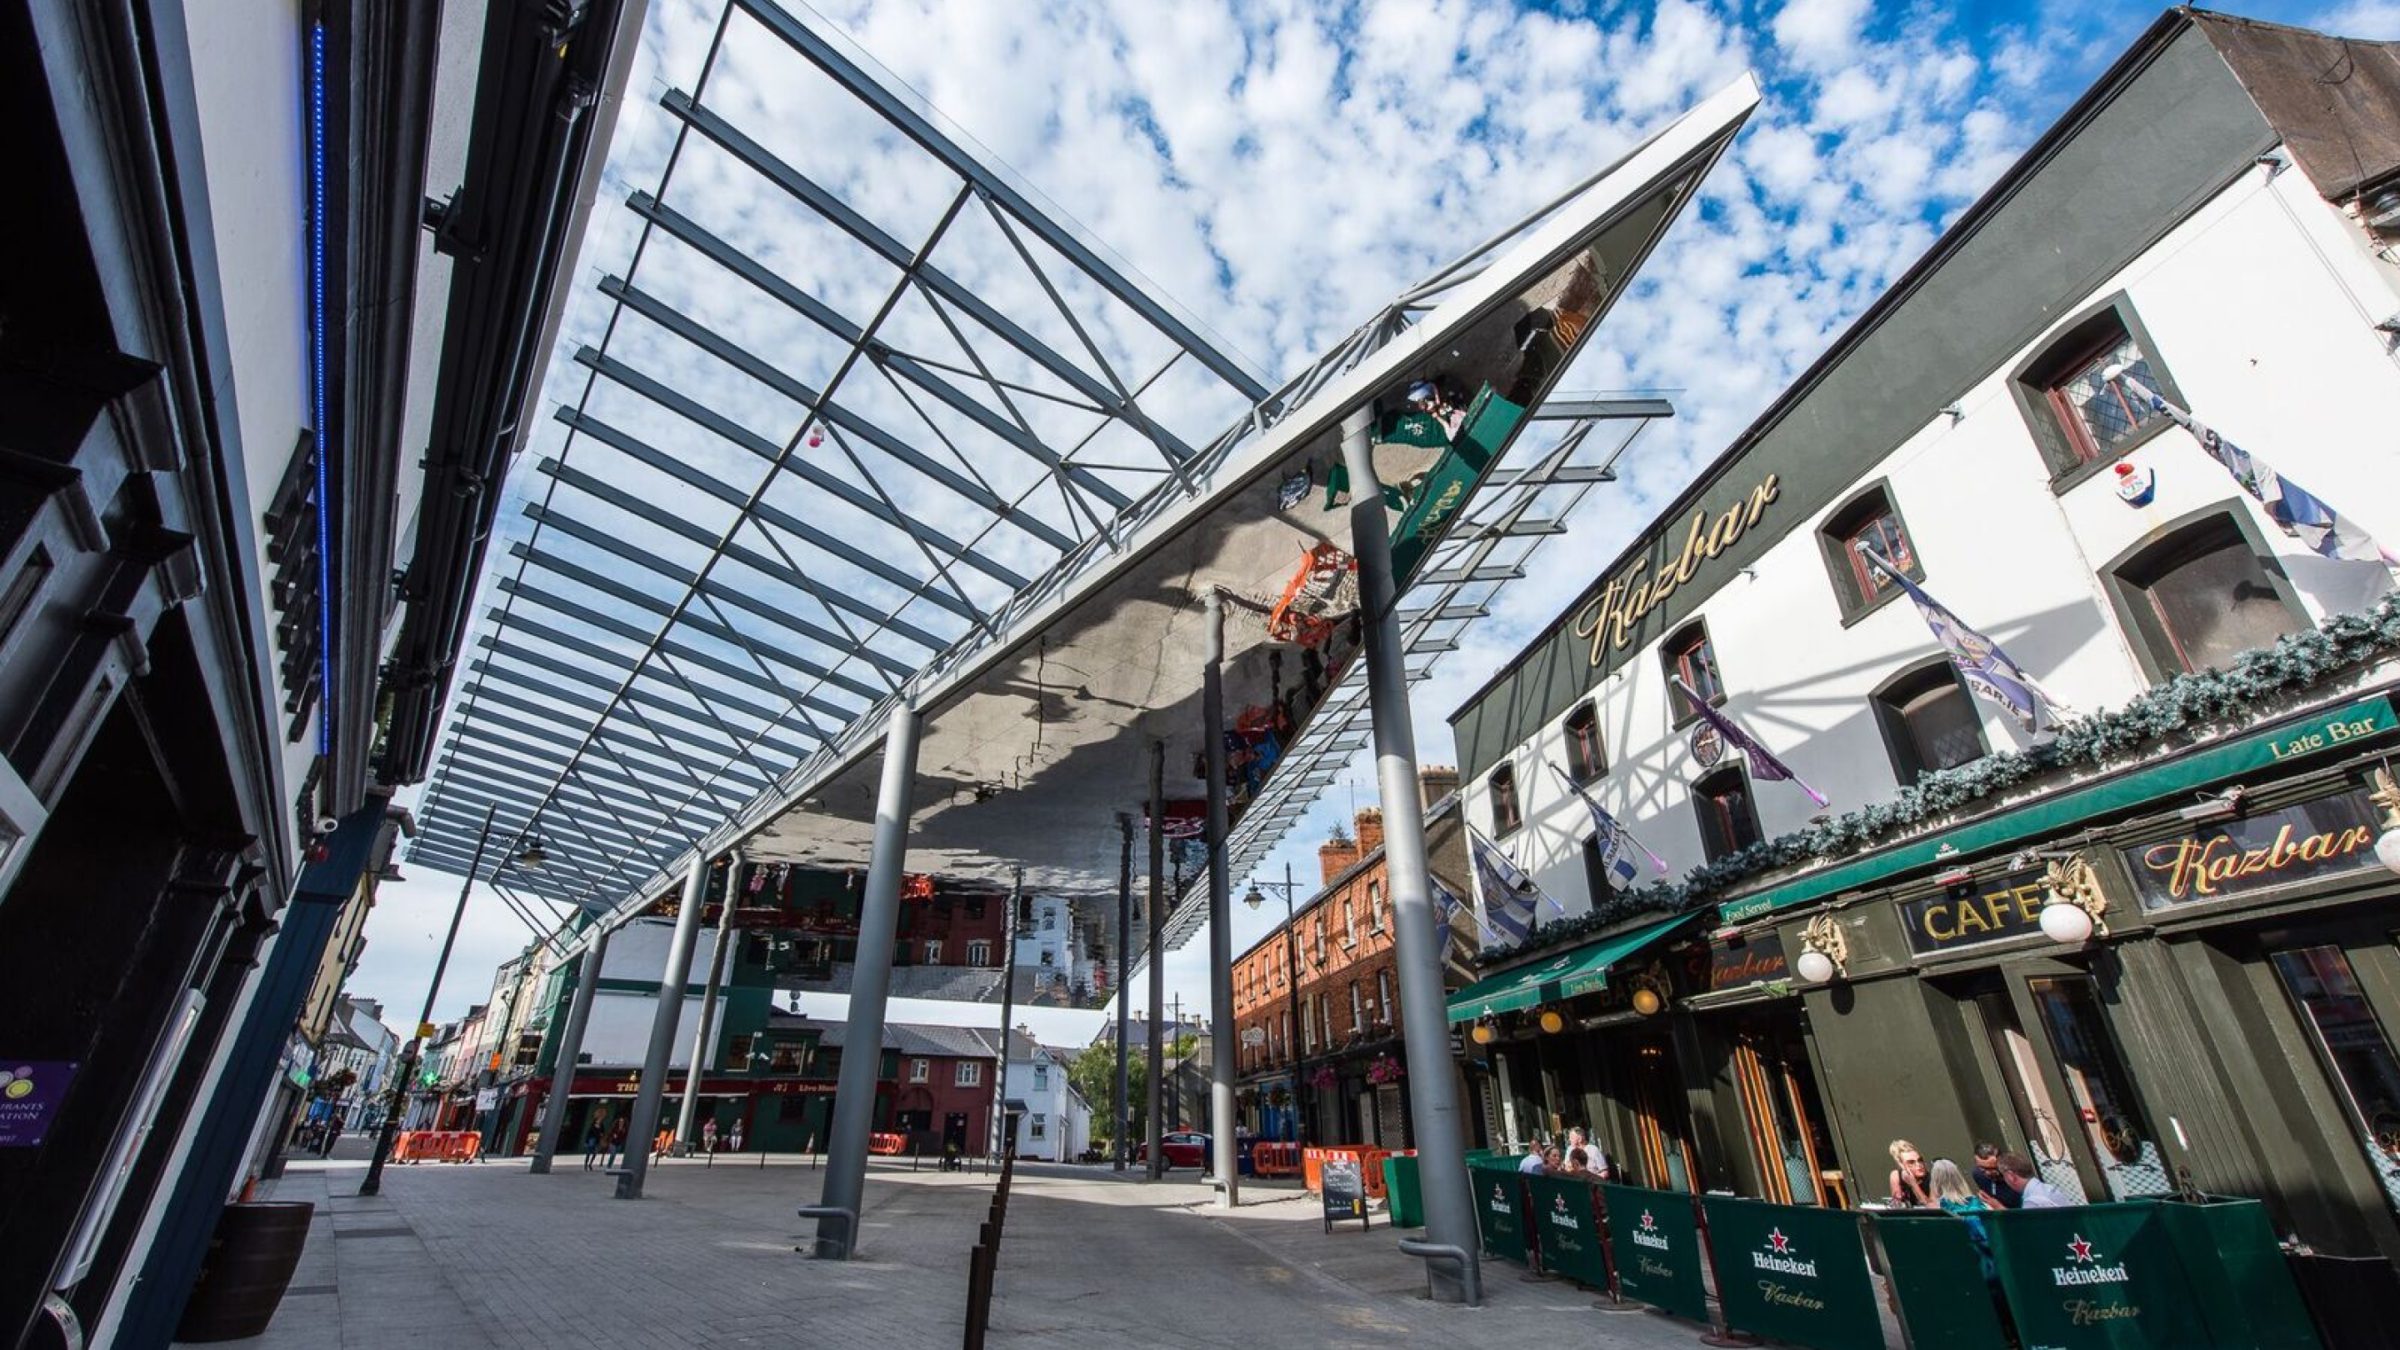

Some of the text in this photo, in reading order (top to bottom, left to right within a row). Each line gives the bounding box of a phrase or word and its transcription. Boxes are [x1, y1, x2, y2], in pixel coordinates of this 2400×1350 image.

[1576, 473, 1780, 668] Kazbar
[2269, 716, 2377, 760] Late Bar
[2144, 822, 2373, 899] Kazbar
[1923, 883, 2041, 941] CAFE
[1632, 1229, 1669, 1250] Heineken
[1752, 1251, 1817, 1277] Heineken
[2052, 1261, 2129, 1286] Heineken
[1757, 1280, 1825, 1310] Kazbar
[2063, 1299, 2140, 1326] Kazbar
